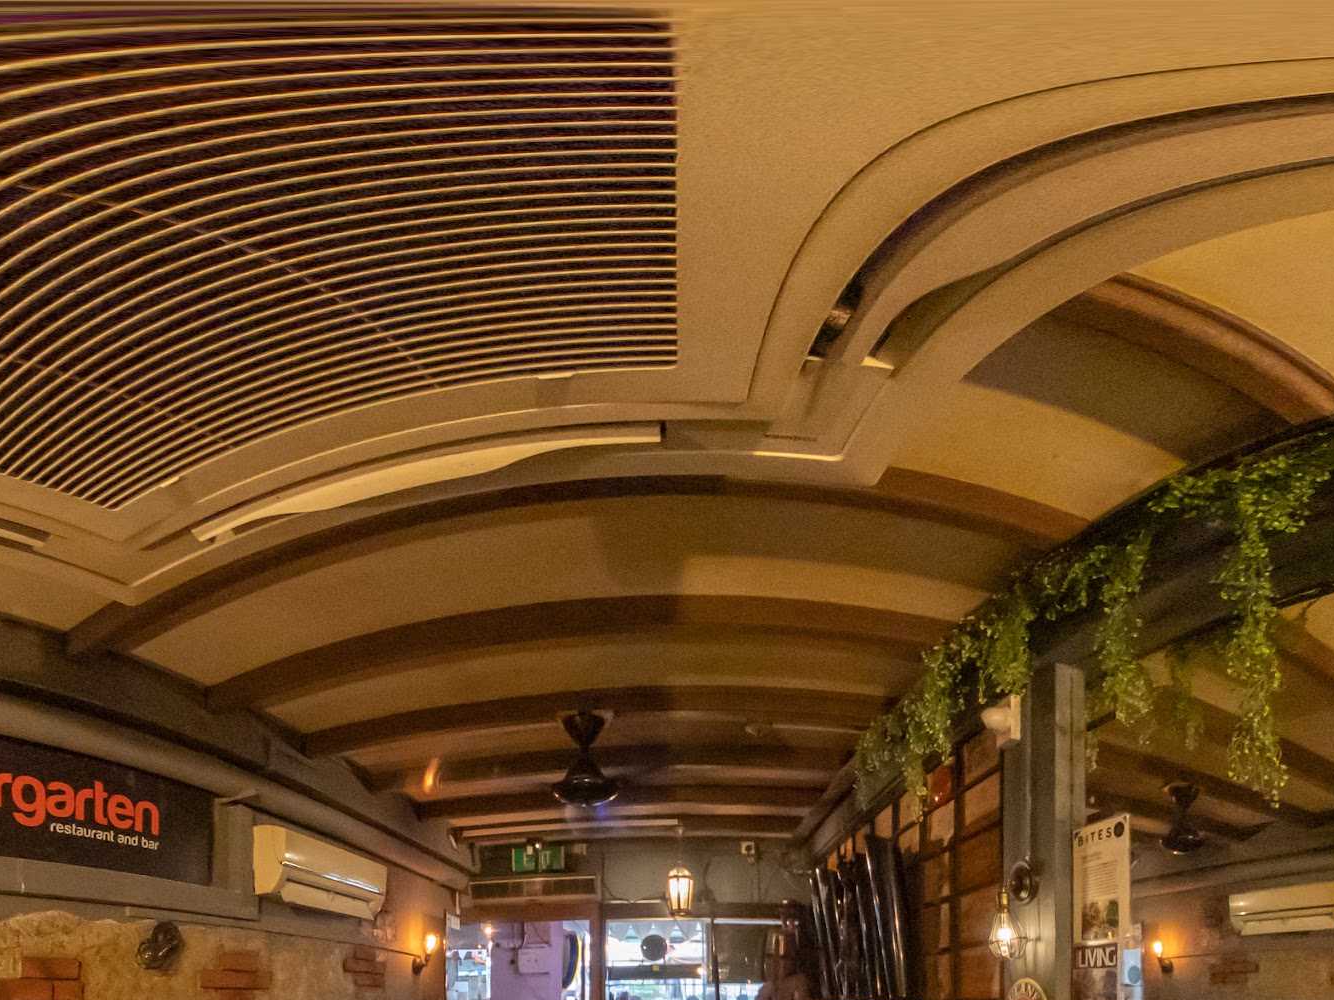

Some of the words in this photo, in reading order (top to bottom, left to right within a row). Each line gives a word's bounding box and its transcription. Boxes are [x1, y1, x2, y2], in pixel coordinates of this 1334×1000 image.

[50, 821, 115, 842] restaurant
[118, 832, 139, 849] and
[141, 835, 159, 850] bar
[1077, 827, 1112, 847] BITES
[1078, 947, 1116, 968] LIVING
